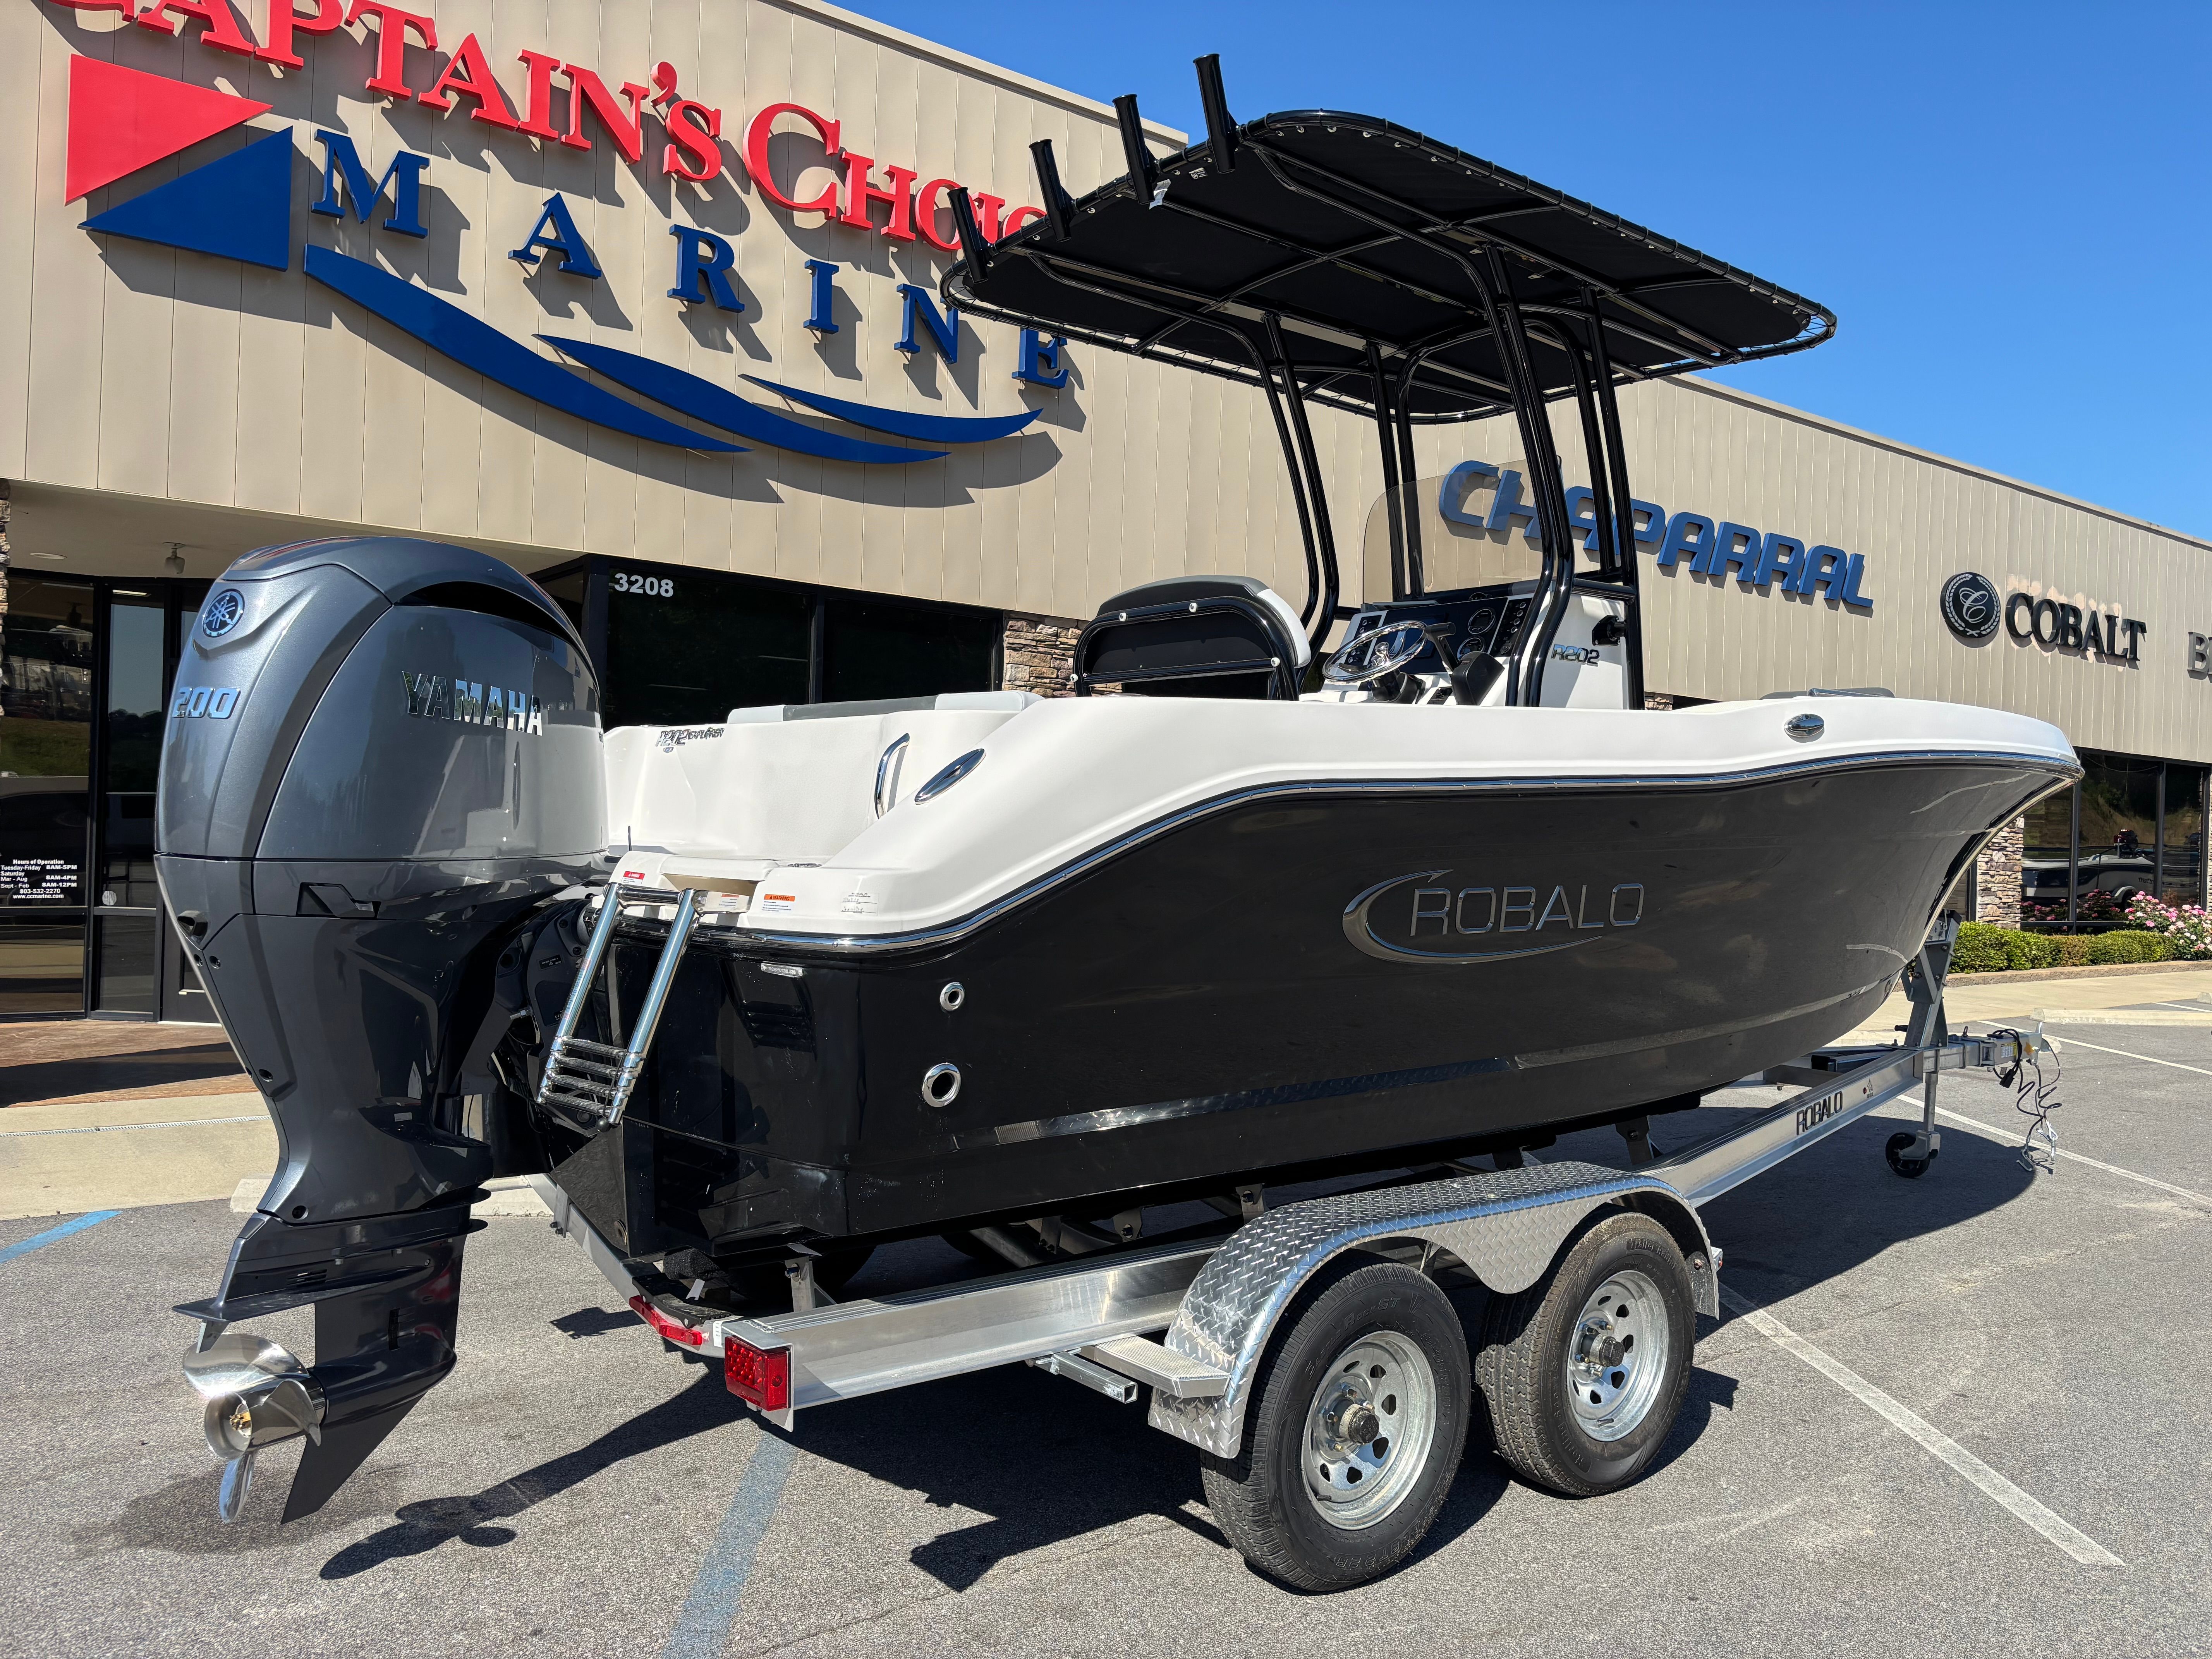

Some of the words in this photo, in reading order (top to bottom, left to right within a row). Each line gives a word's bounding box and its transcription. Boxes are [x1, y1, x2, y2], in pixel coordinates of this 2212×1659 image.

[48, 0, 721, 183] APTAIN'S
[311, 129, 1068, 389] MARINE
[1439, 460, 1874, 608] CHAPARRAL
[614, 573, 674, 598] 3208
[2006, 592, 2147, 661] COBALT
[1551, 644, 1600, 666] R202
[2188, 632, 2212, 677] B
[172, 687, 241, 720] 200
[401, 670, 543, 737] YAMAHA
[1410, 883, 1644, 936] ROBALO
[1796, 1090, 1843, 1136] ROBALO
[1378, 1298, 1401, 1310] ST
